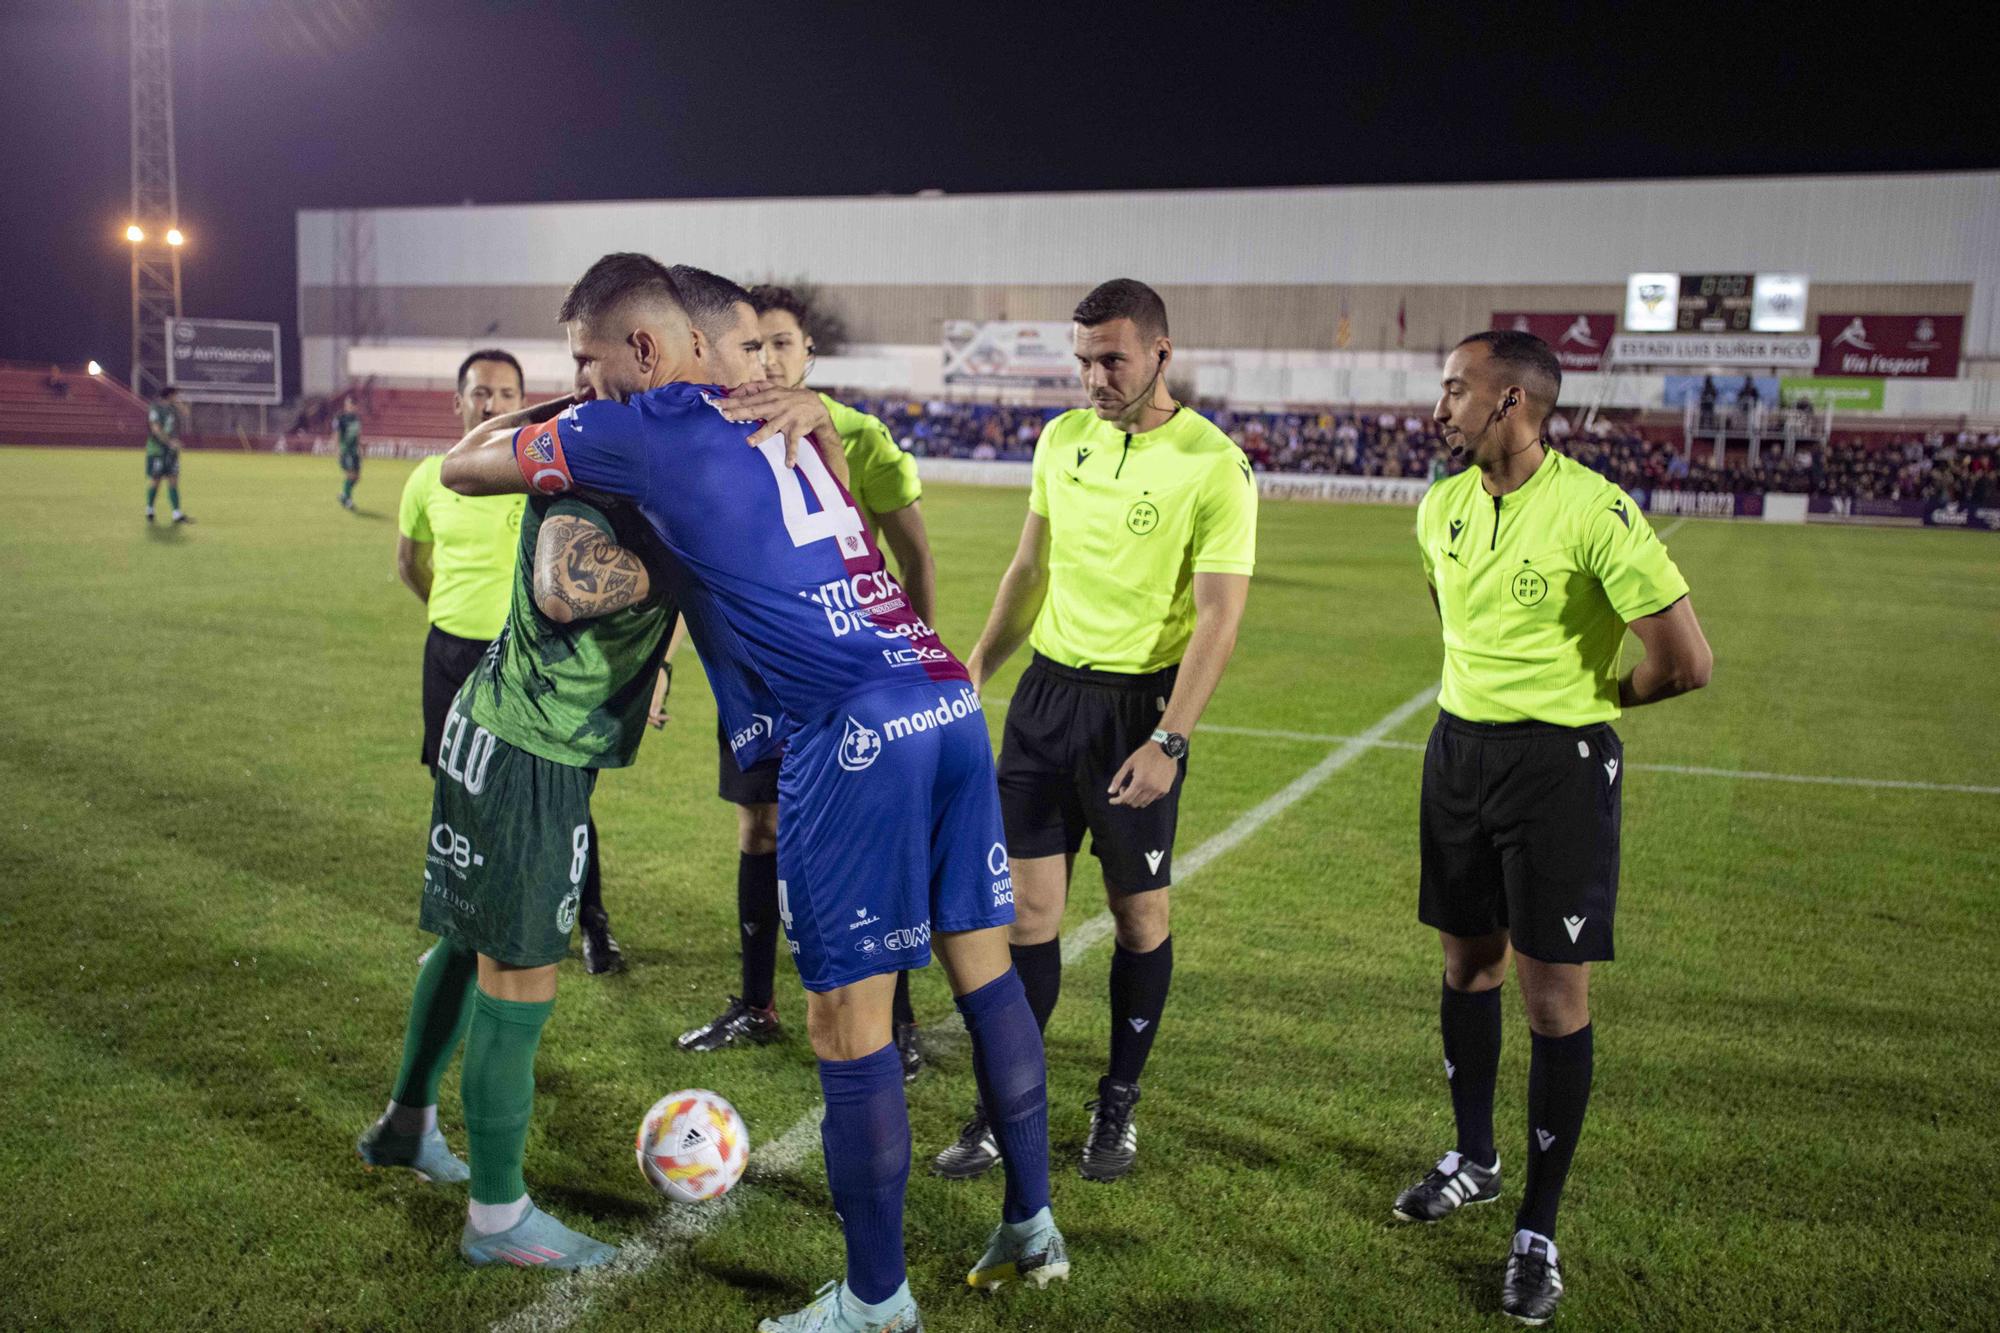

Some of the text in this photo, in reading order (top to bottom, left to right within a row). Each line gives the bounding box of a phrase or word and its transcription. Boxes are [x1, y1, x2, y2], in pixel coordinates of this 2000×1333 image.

[1621, 339, 1812, 358] ESTADI LUIS SUÑER PICÓ
[757, 432, 870, 560] 4
[569, 824, 589, 884] 8
[987, 842, 1009, 876] Q
